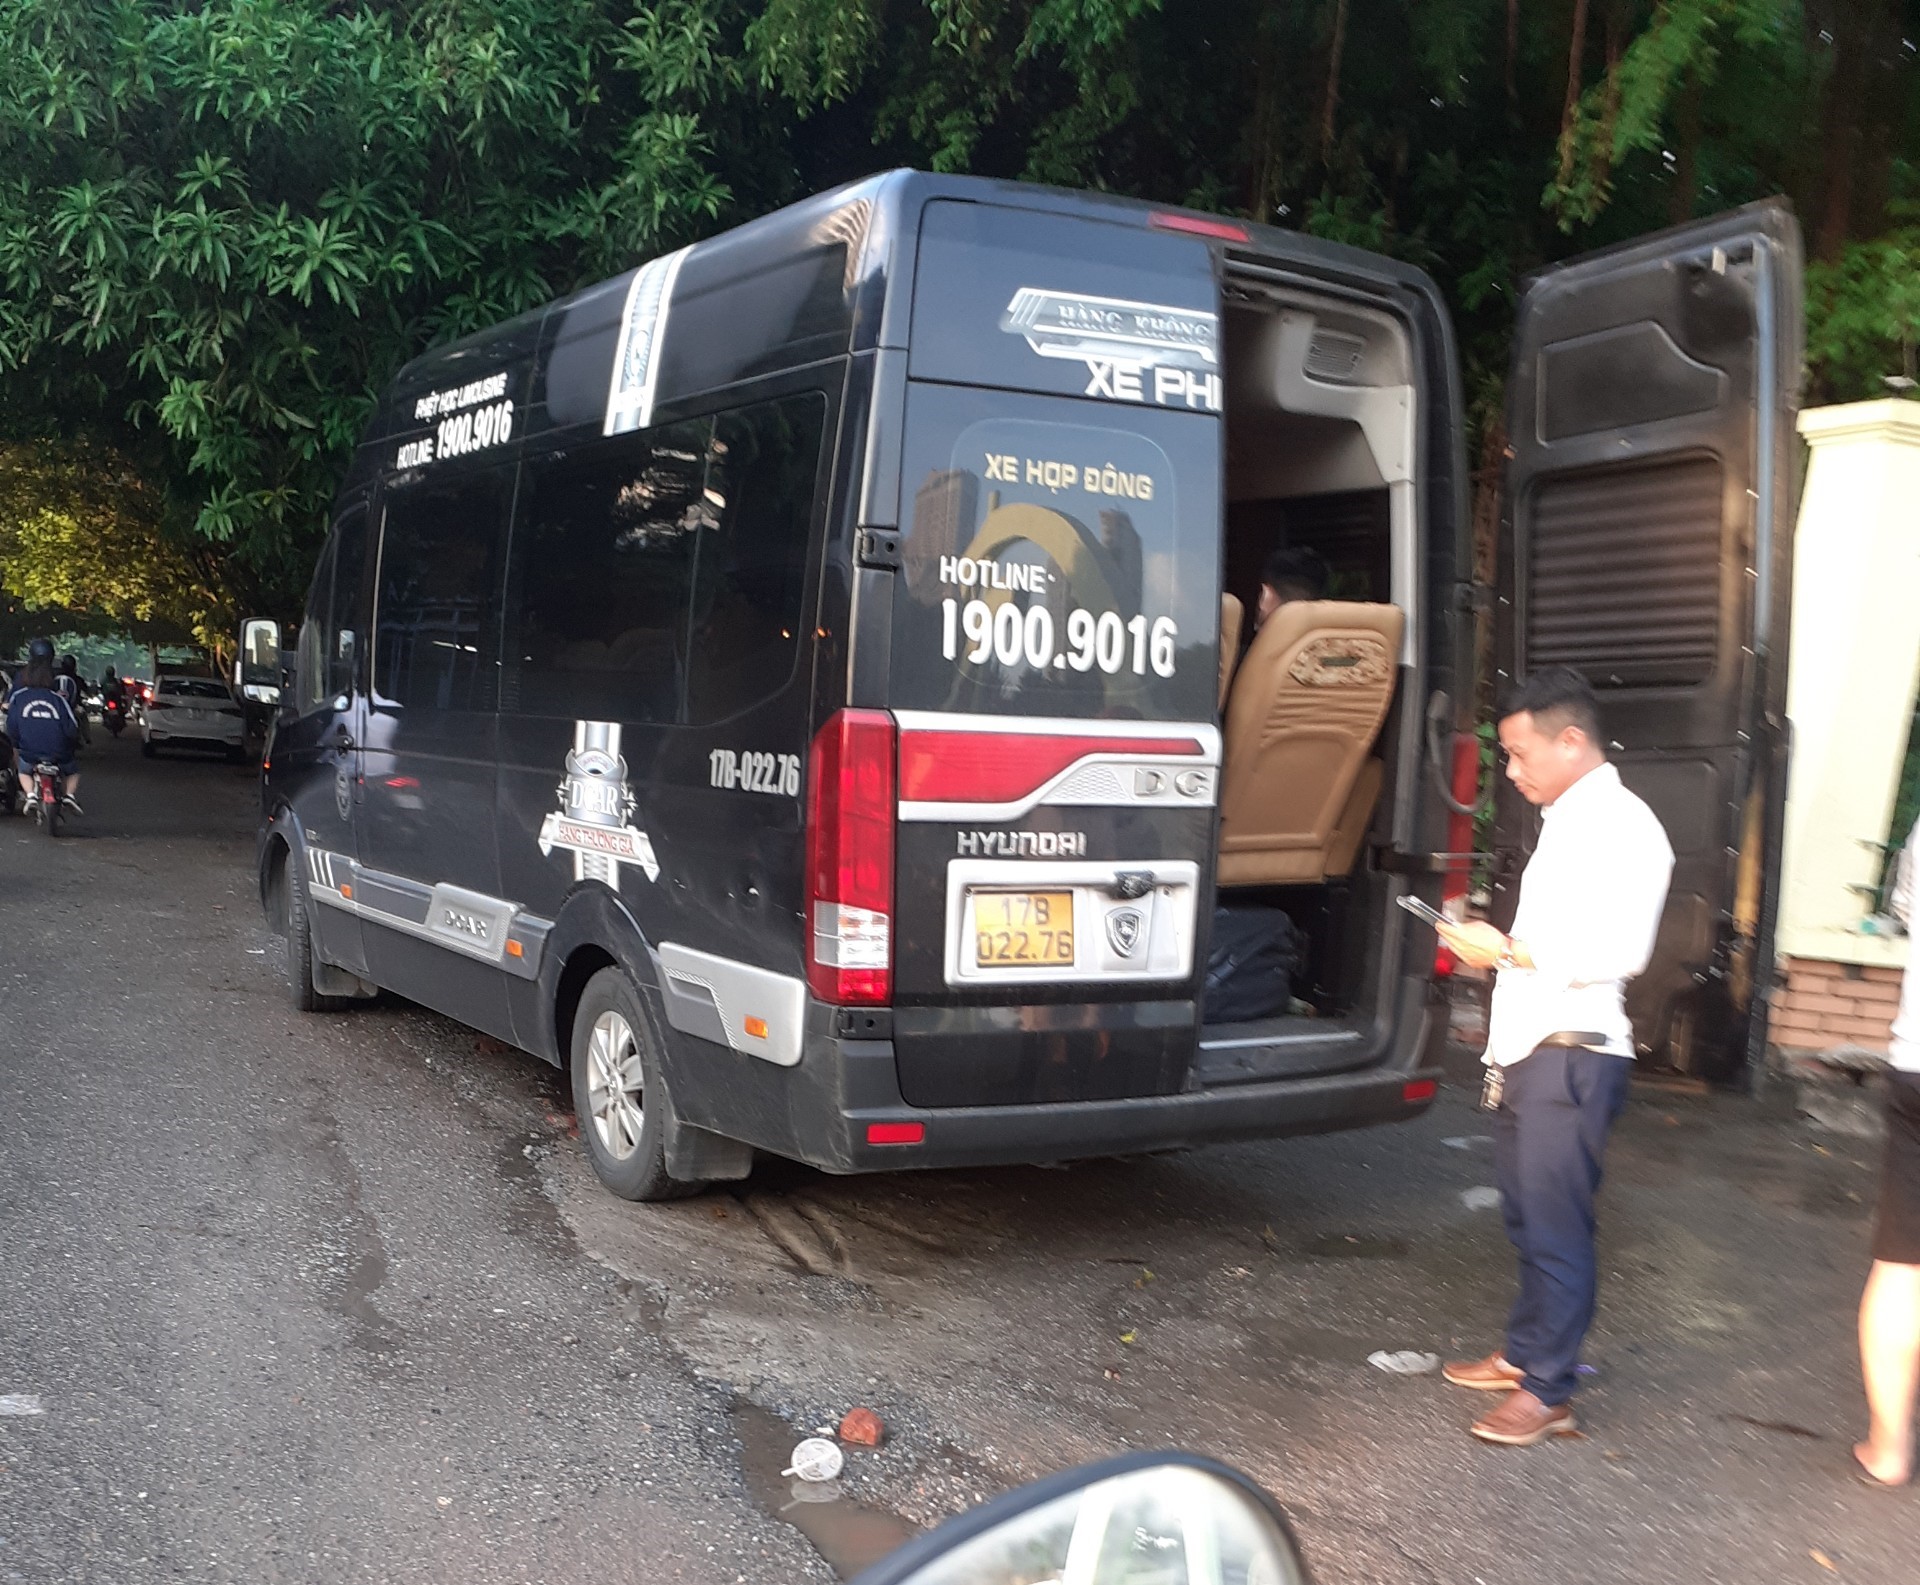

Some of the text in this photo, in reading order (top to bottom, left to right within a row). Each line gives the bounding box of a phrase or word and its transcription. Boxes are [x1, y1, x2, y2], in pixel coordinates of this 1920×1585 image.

[1084, 360, 1144, 401] XE
[437, 400, 514, 459] 1900.9016
[984, 453, 1018, 483] XE
[1025, 458, 1077, 494] HỢP
[942, 598, 1178, 678] 1900.9016
[709, 748, 801, 797] 17B-022.76
[570, 780, 621, 817] DCAR
[957, 831, 1087, 856] HYUNDAI
[1002, 896, 1049, 926] 17B
[977, 930, 1072, 960] 022.76
